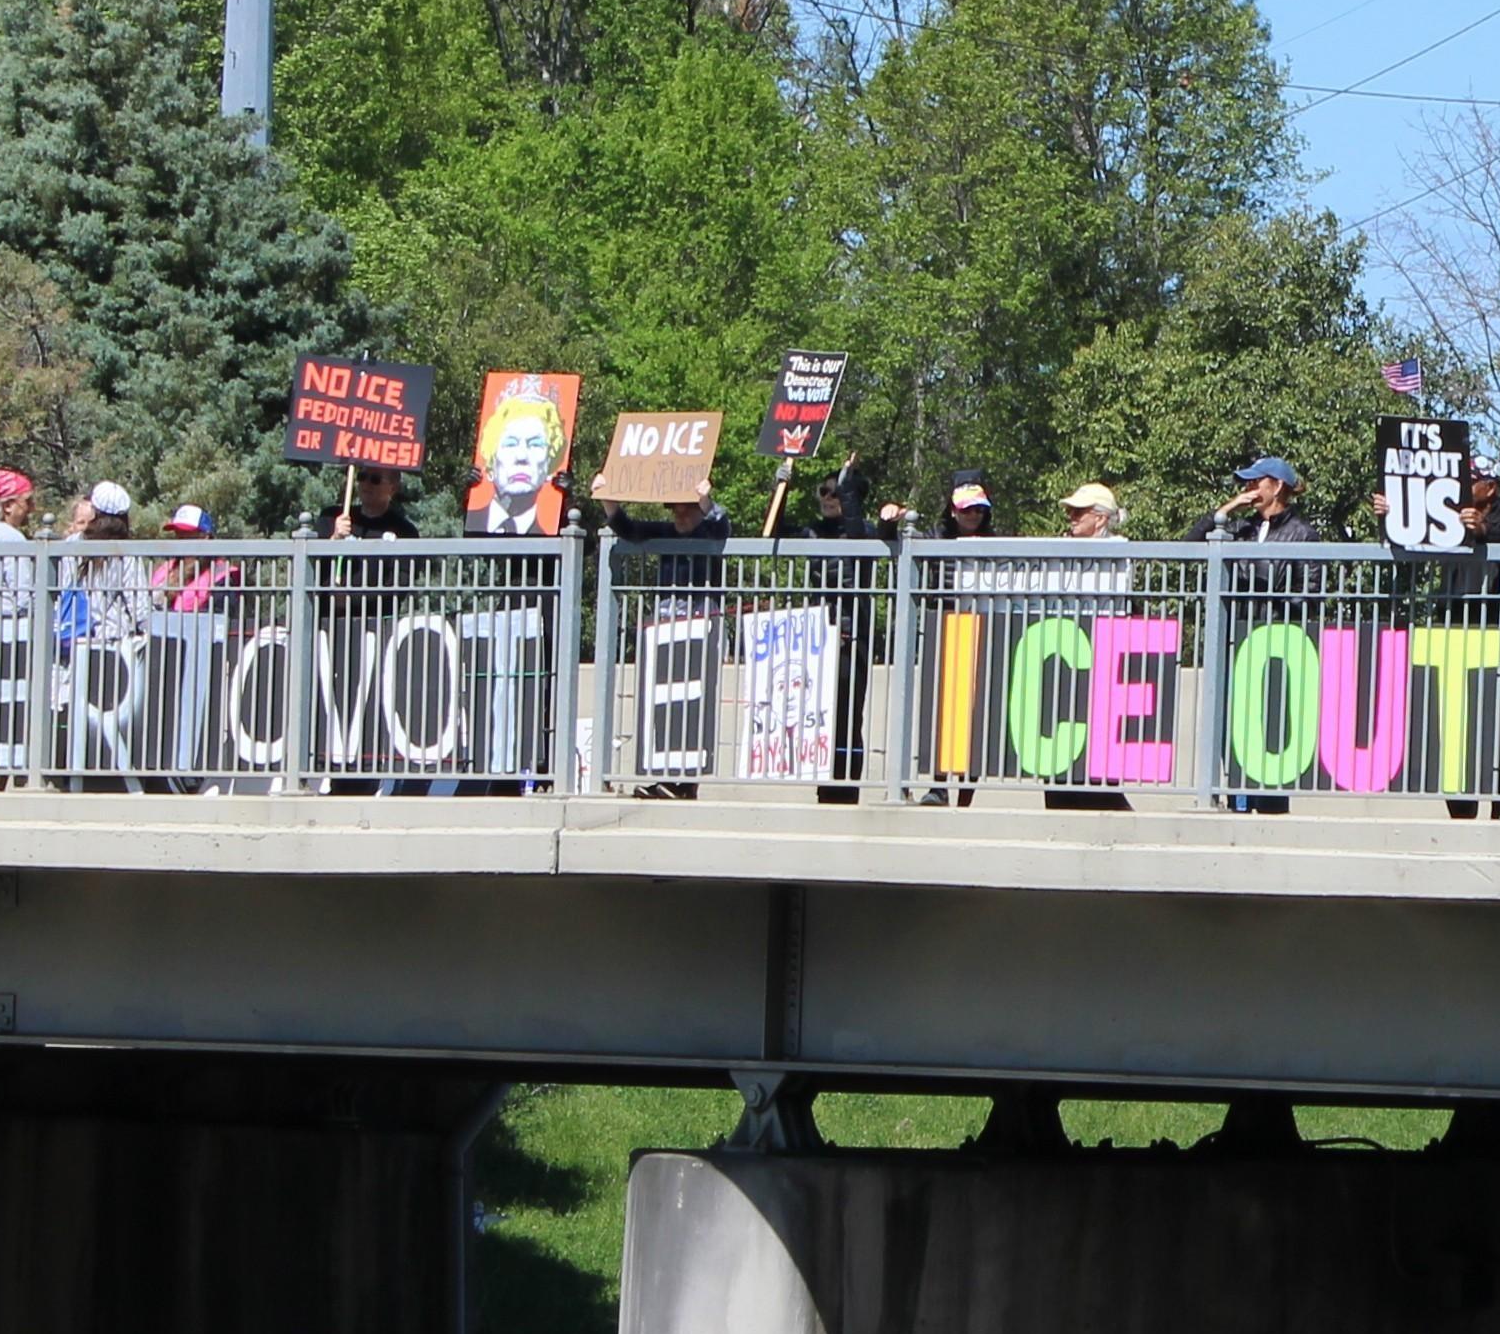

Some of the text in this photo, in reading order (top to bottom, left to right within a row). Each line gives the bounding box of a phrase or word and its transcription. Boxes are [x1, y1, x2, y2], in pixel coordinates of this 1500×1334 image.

[789, 357, 811, 372] This
[811, 358, 821, 373] is
[303, 362, 404, 410] NO ICE,
[787, 386, 806, 402] We
[774, 403, 797, 421] NO
[296, 429, 421, 467] OR KINGS!
[620, 420, 708, 457] NO ICE
[1401, 422, 1443, 451] IT'S
[1384, 448, 1462, 478] ABOUT
[1384, 475, 1466, 548] US
[314, 607, 714, 775] VOTE
[939, 613, 1180, 784] ICE
